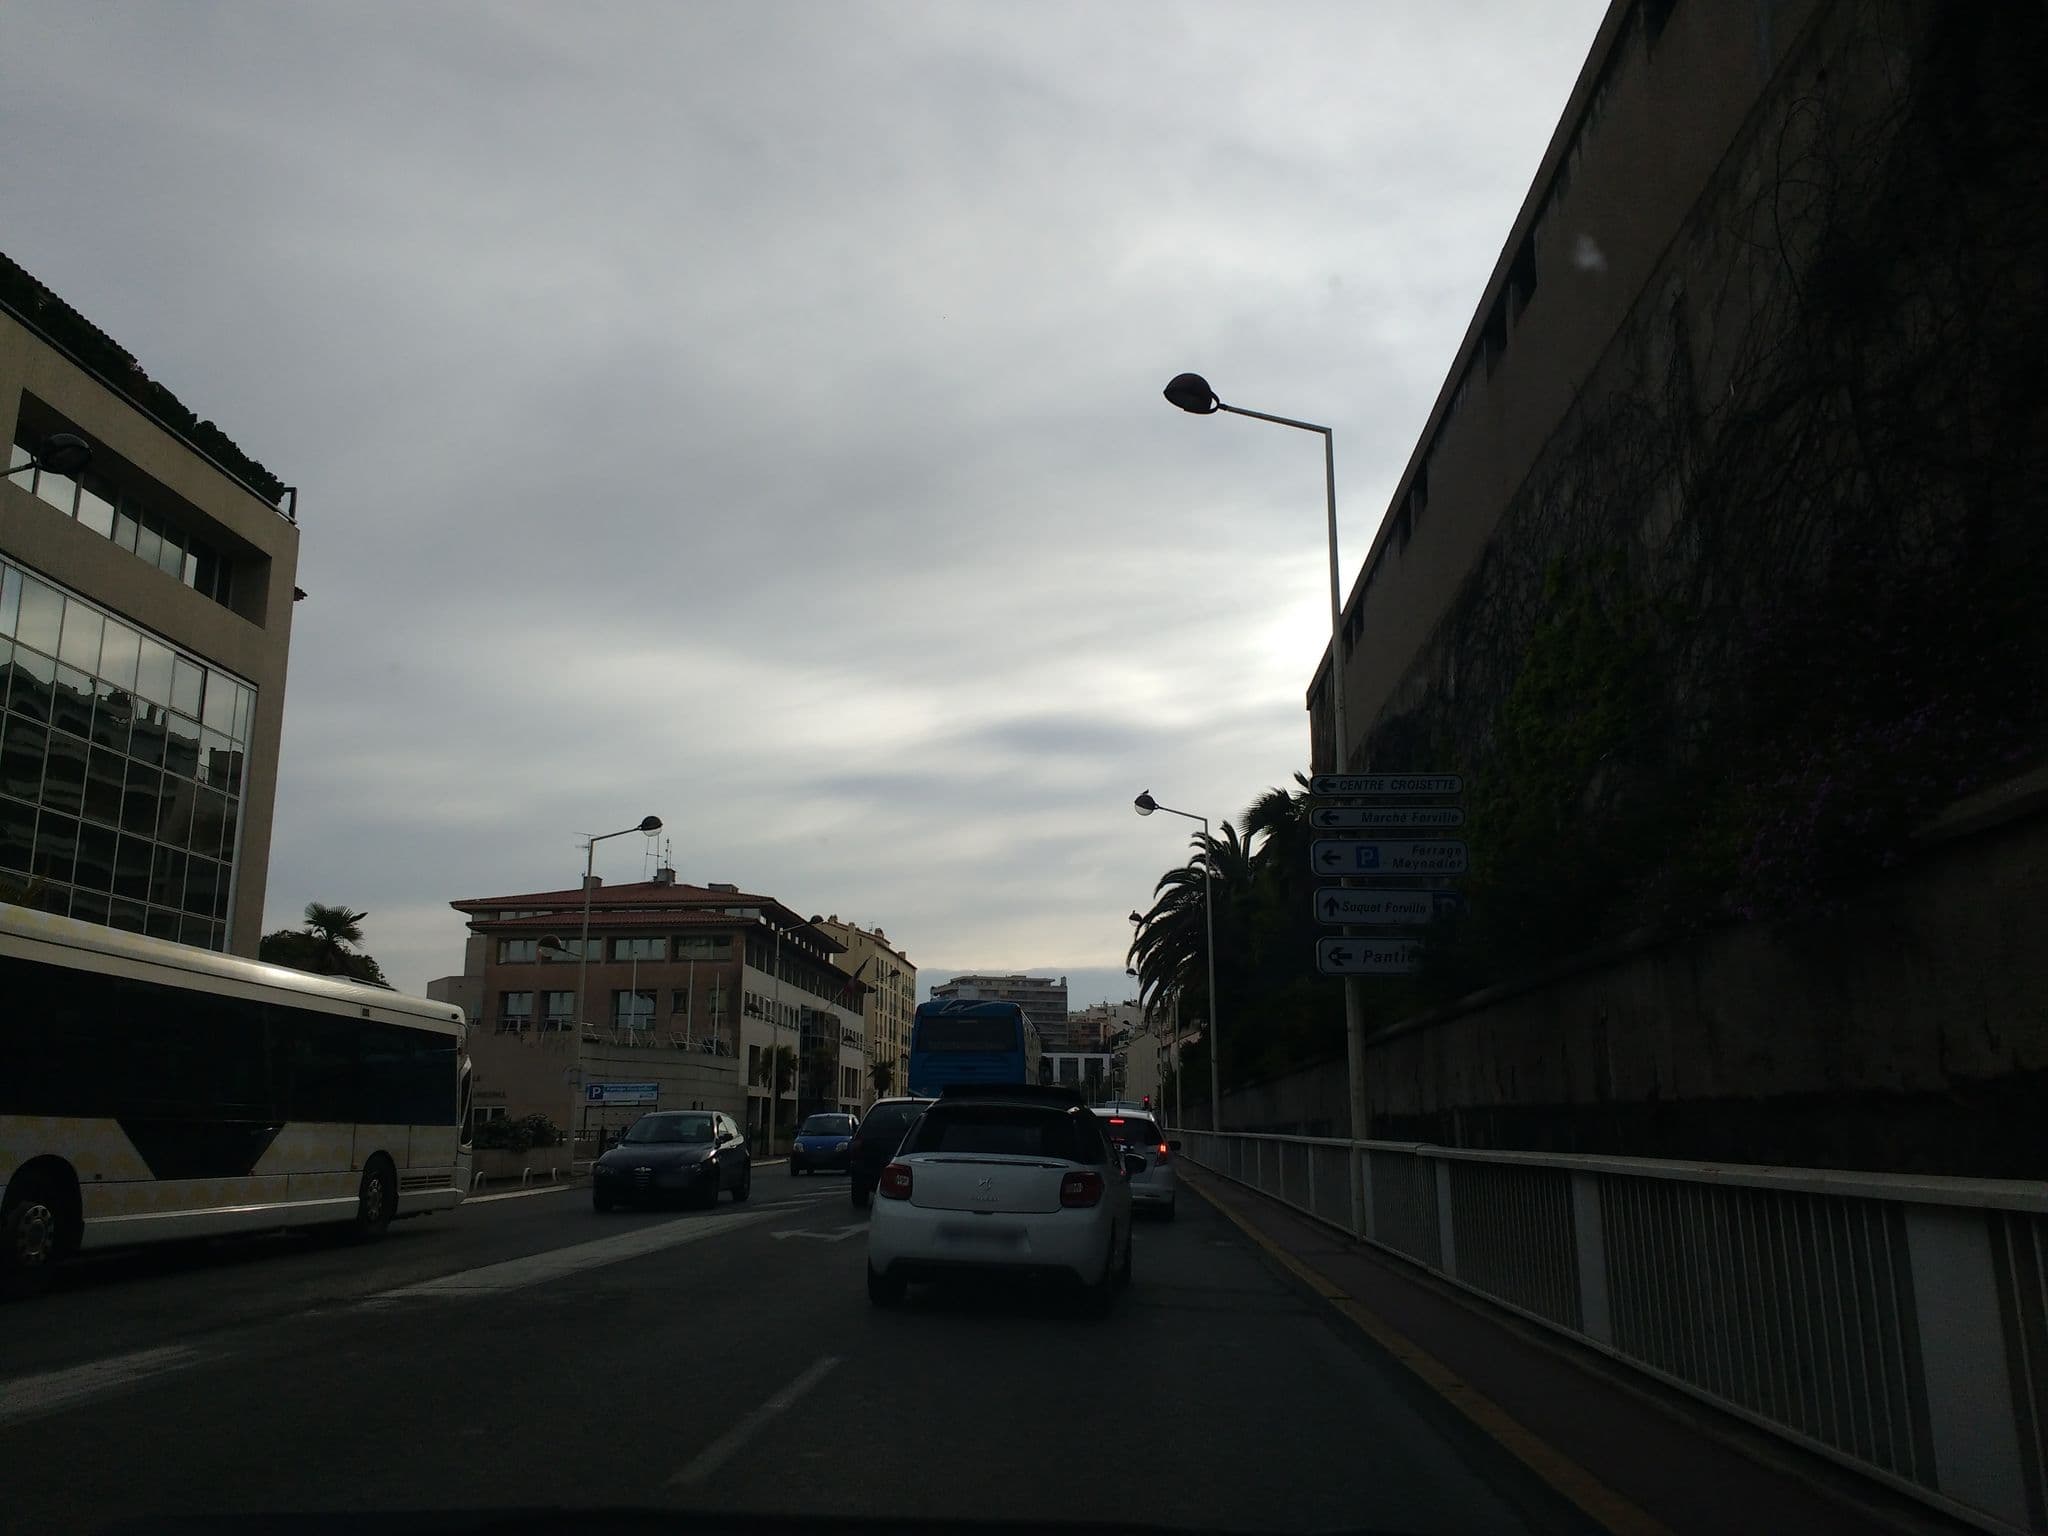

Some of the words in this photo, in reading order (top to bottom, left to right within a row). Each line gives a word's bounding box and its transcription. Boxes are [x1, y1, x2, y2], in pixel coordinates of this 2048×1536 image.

[1339, 779, 1385, 791] CENTRE
[1391, 779, 1457, 791] CROISETTE
[1411, 811, 1459, 823] Forville
[592, 1086, 602, 1099] P
